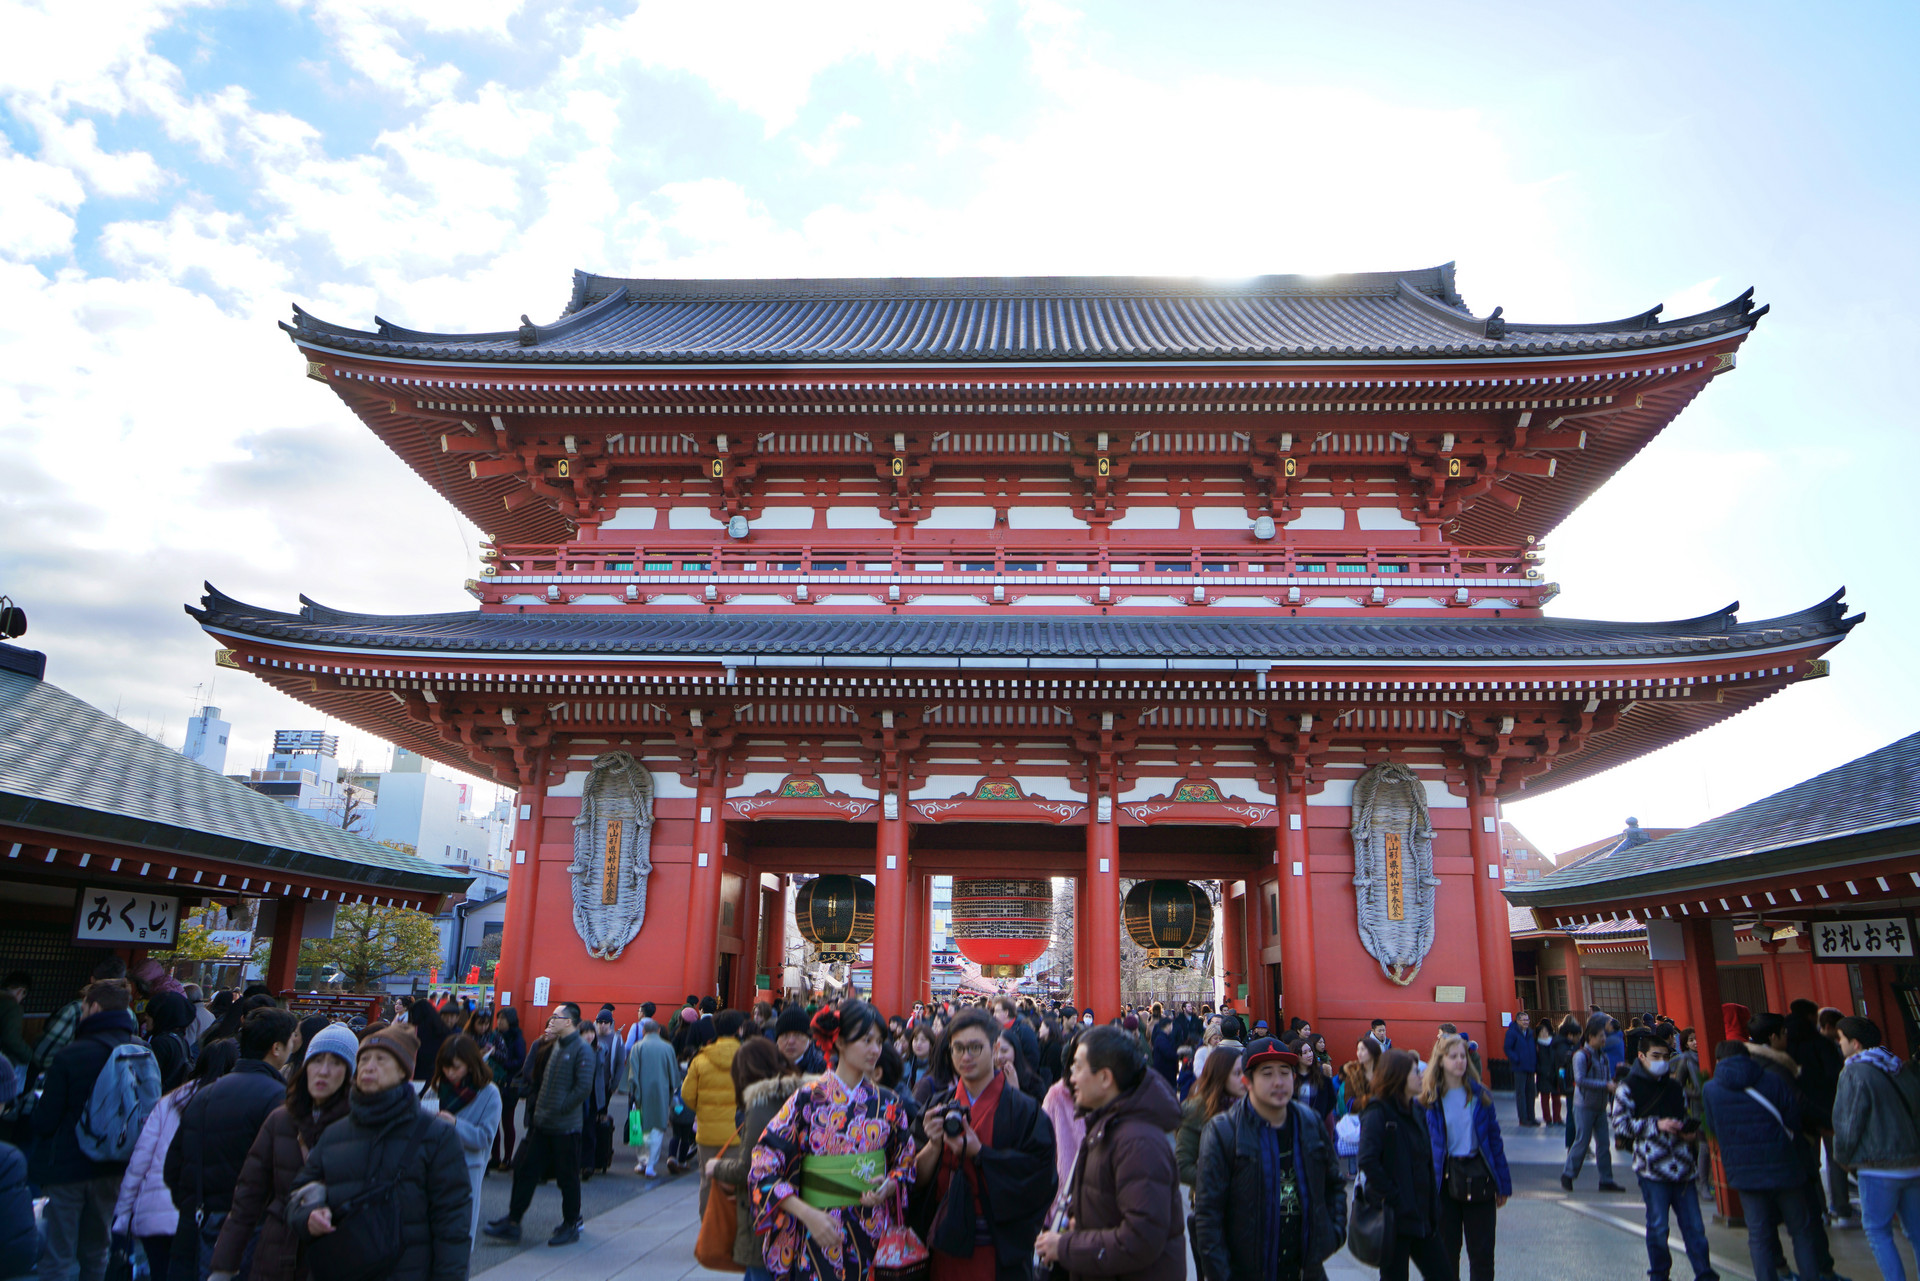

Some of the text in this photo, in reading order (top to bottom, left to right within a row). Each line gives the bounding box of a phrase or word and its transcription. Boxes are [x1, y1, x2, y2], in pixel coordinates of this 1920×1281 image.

[88, 896, 168, 932] みくじ
[139, 928, 168, 939] 百円
[1821, 921, 1905, 953] お札お守
